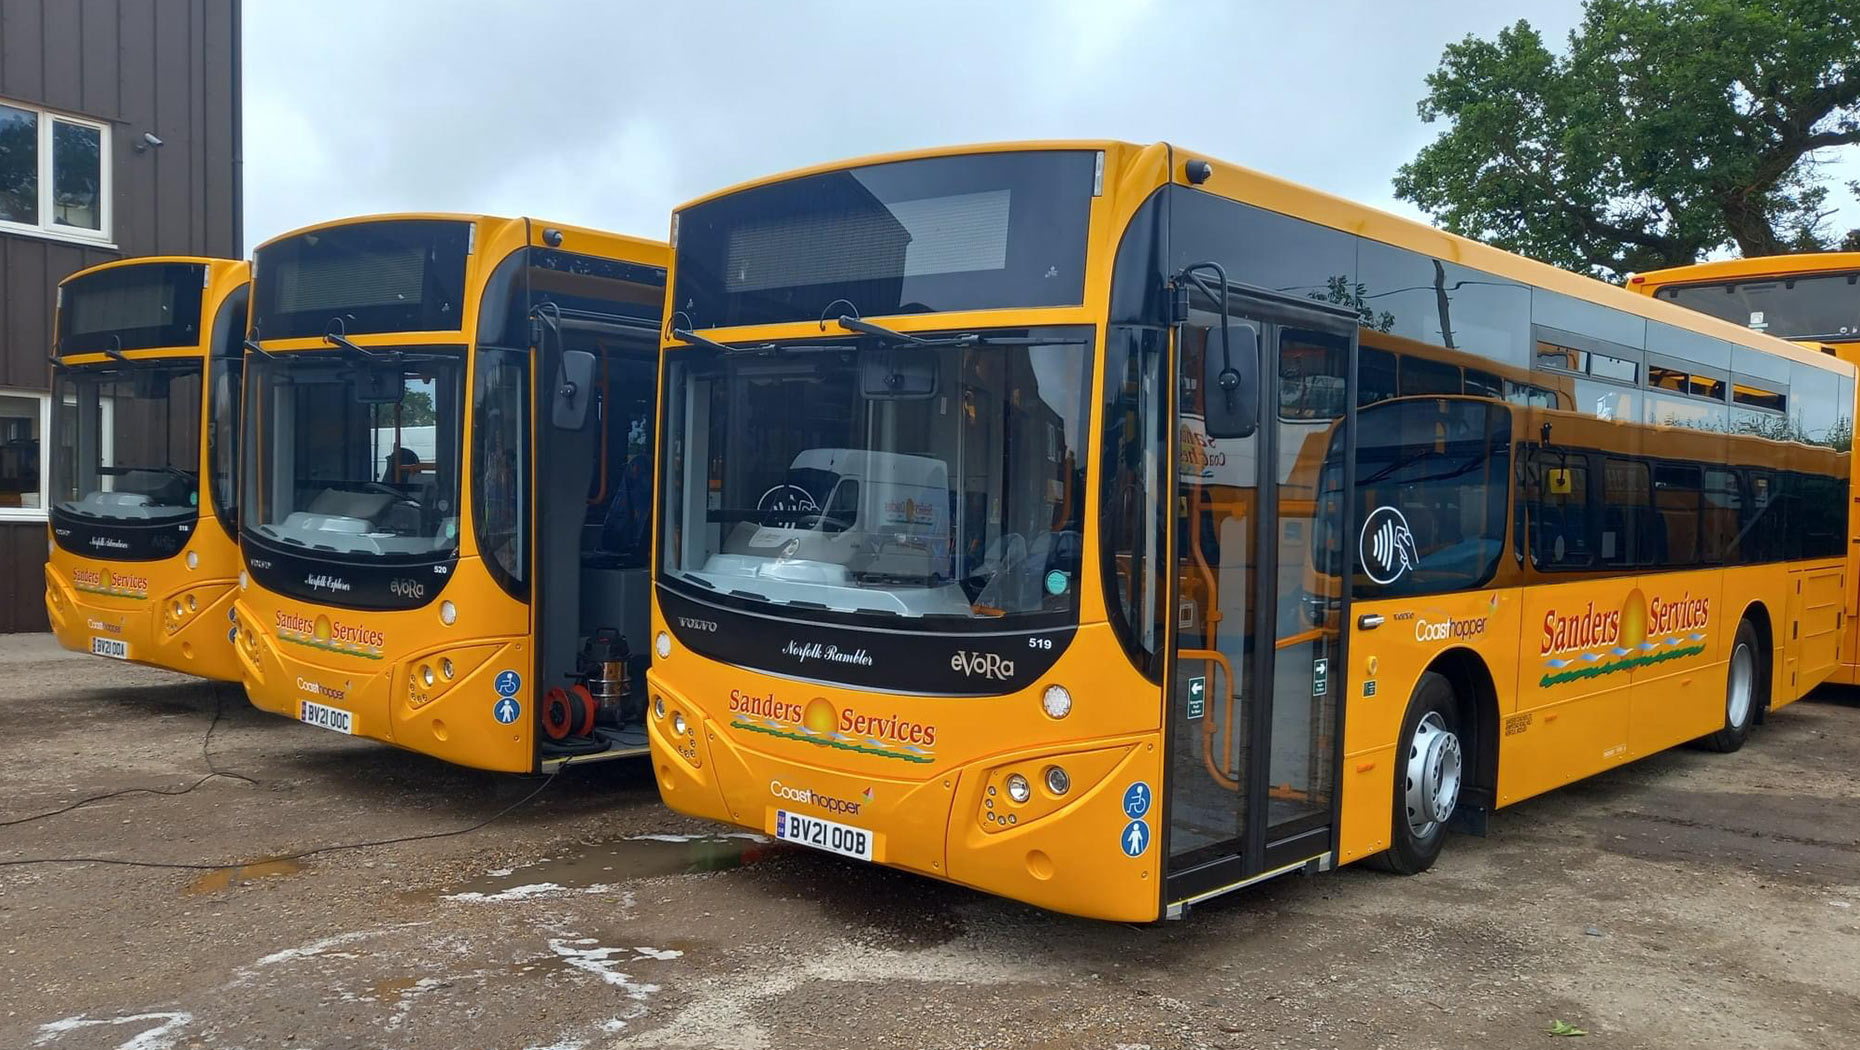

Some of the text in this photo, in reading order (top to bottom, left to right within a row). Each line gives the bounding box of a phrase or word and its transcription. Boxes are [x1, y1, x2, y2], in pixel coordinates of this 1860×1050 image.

[73, 567, 148, 590] Sanders Services
[434, 565, 447, 574] 520
[275, 610, 384, 647] Sanders Services
[678, 616, 718, 633] VOLVO
[1415, 617, 1487, 641] Coasthopper
[1541, 591, 1709, 655] Sanders Services
[97, 639, 112, 654] BV21
[782, 639, 873, 667] Norfolk Rambler
[1028, 637, 1052, 650] 519
[296, 676, 345, 700] Coasthopper
[308, 704, 349, 731] BV21 OOC
[729, 689, 936, 746] Sanders Services
[770, 780, 861, 815] Coasthopper
[790, 816, 866, 855] BV21 OOB
